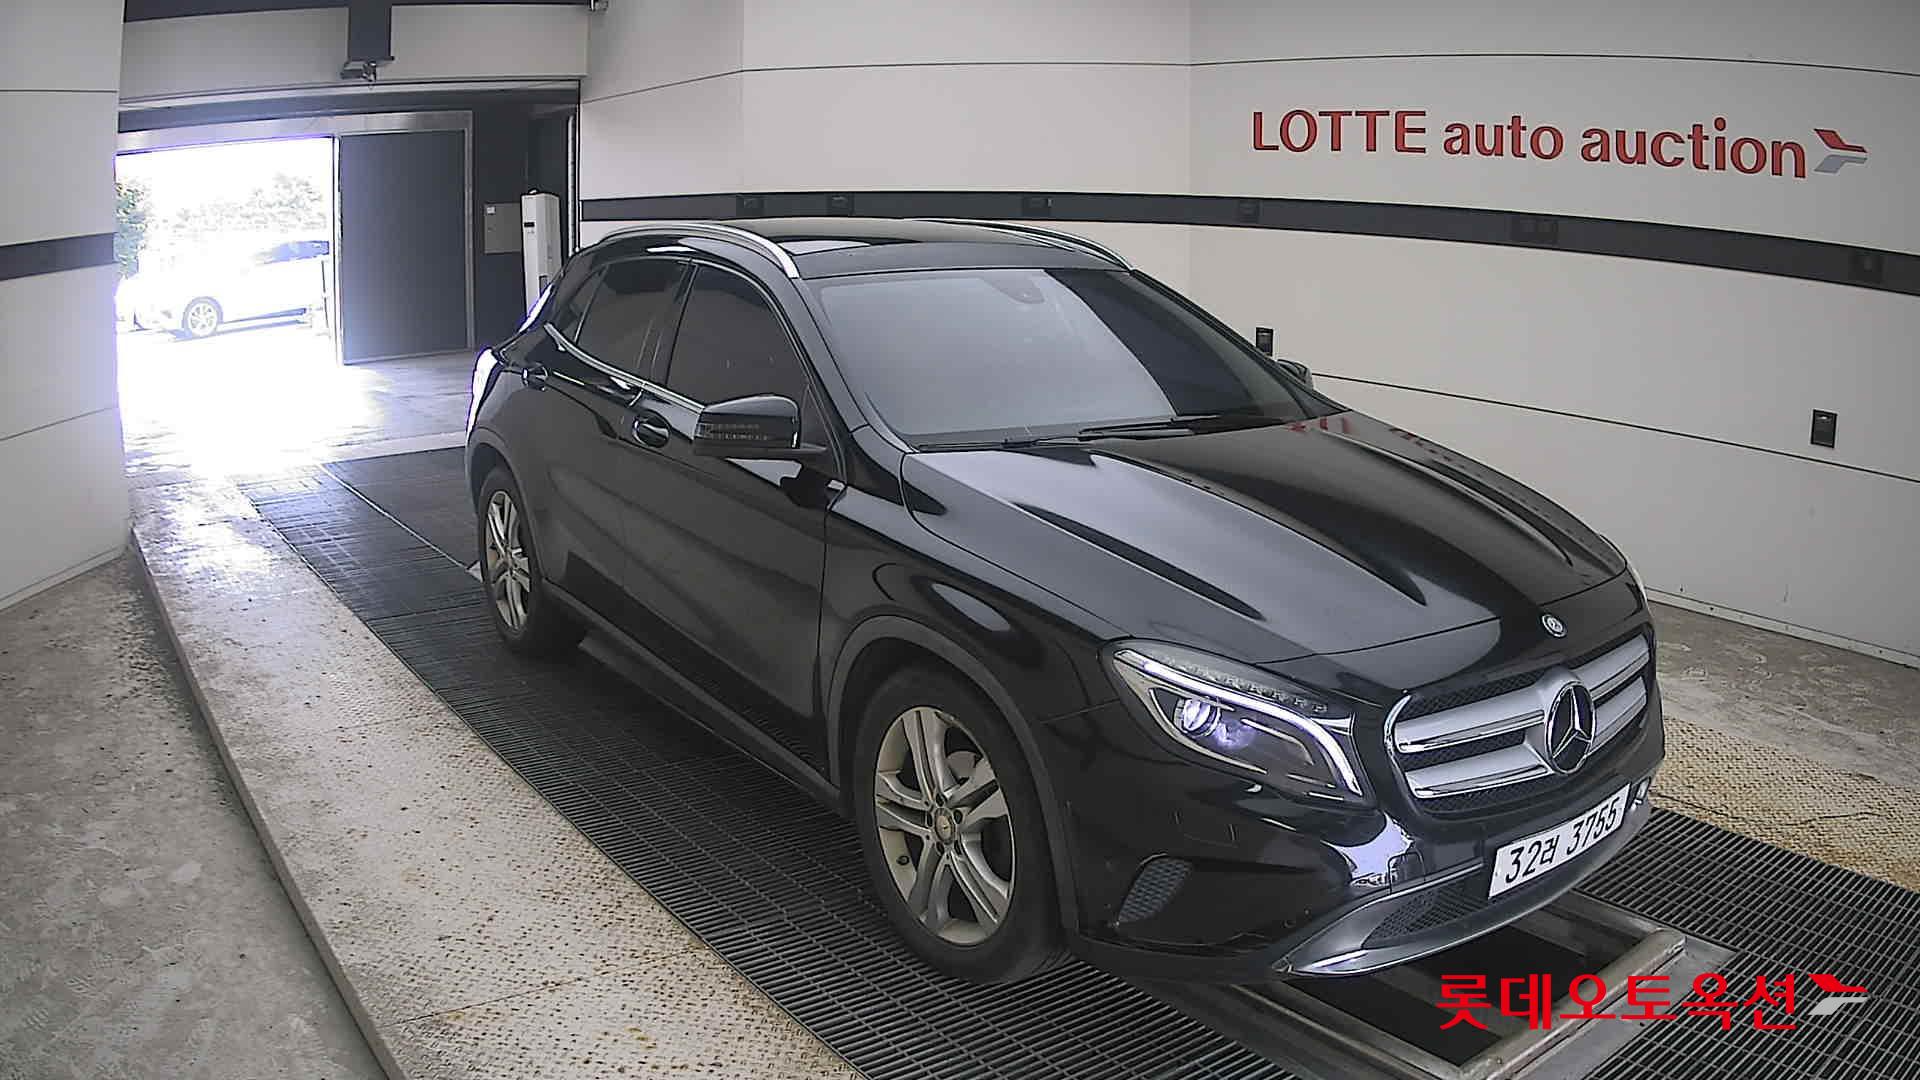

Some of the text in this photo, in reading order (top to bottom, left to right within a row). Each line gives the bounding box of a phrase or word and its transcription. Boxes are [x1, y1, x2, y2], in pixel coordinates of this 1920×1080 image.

[1252, 109, 1808, 179] LOTTE auto auction
[1505, 796, 1620, 884] 32러 3755
